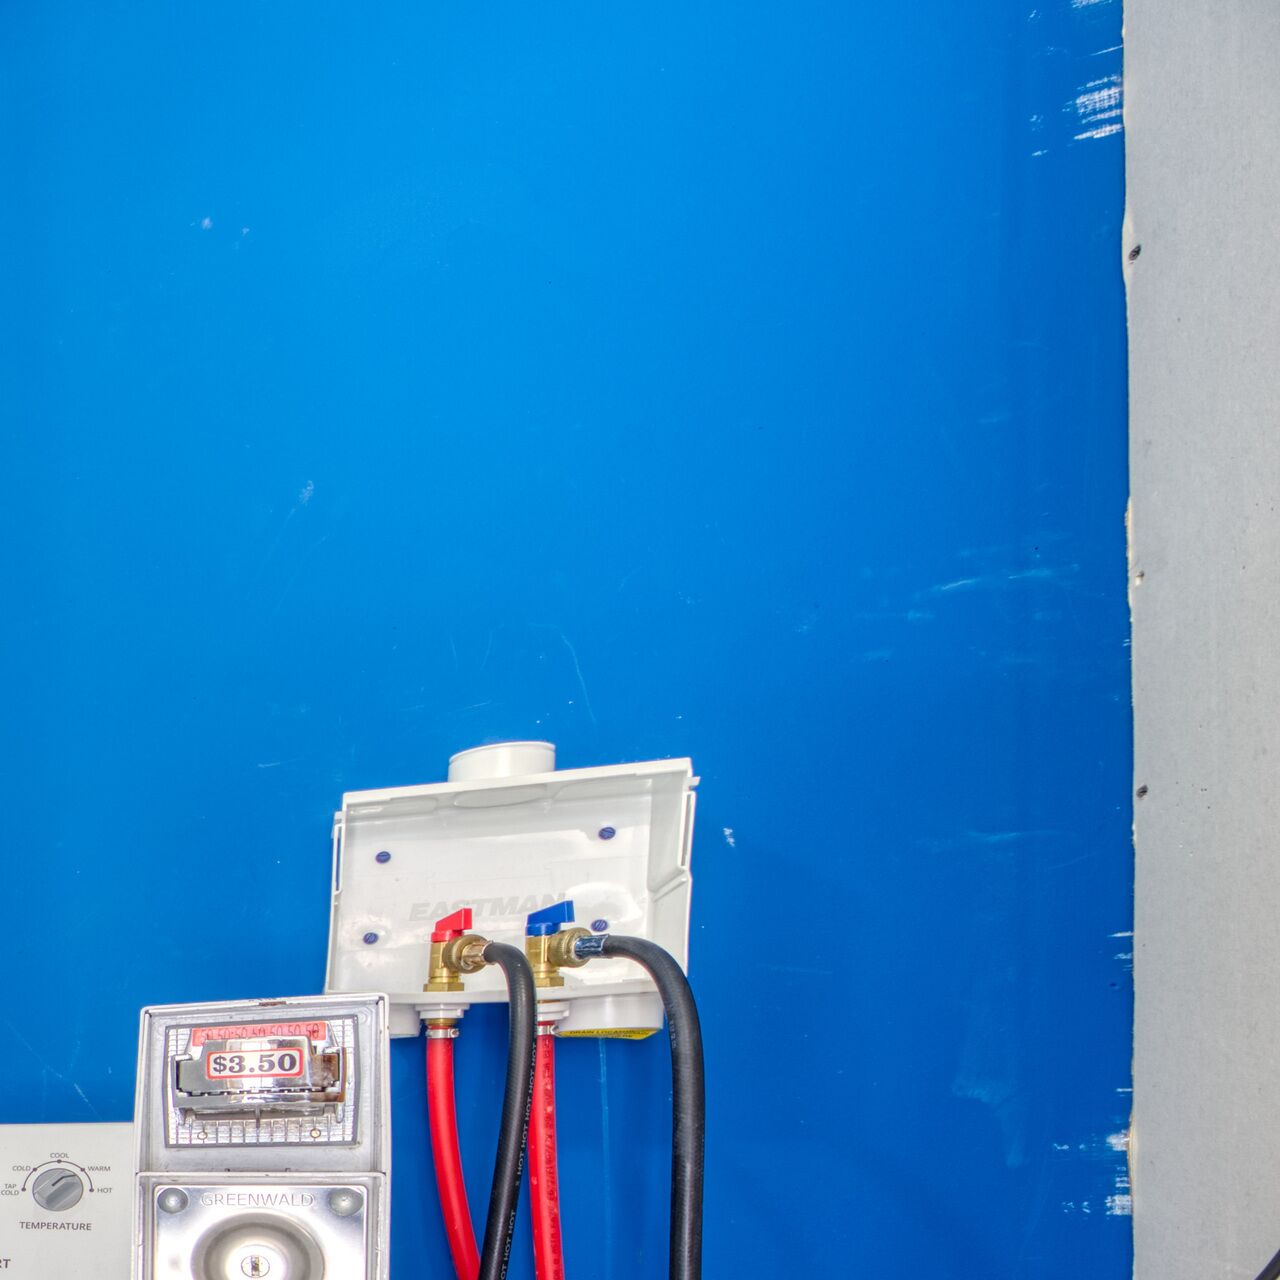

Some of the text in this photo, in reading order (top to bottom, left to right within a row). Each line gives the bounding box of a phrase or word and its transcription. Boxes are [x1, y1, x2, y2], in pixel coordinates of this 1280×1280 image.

[213, 1054, 296, 1074] $3.50
[201, 1192, 314, 1207] GREENWALD
[20, 1221, 91, 1231] TEMPERATURE
